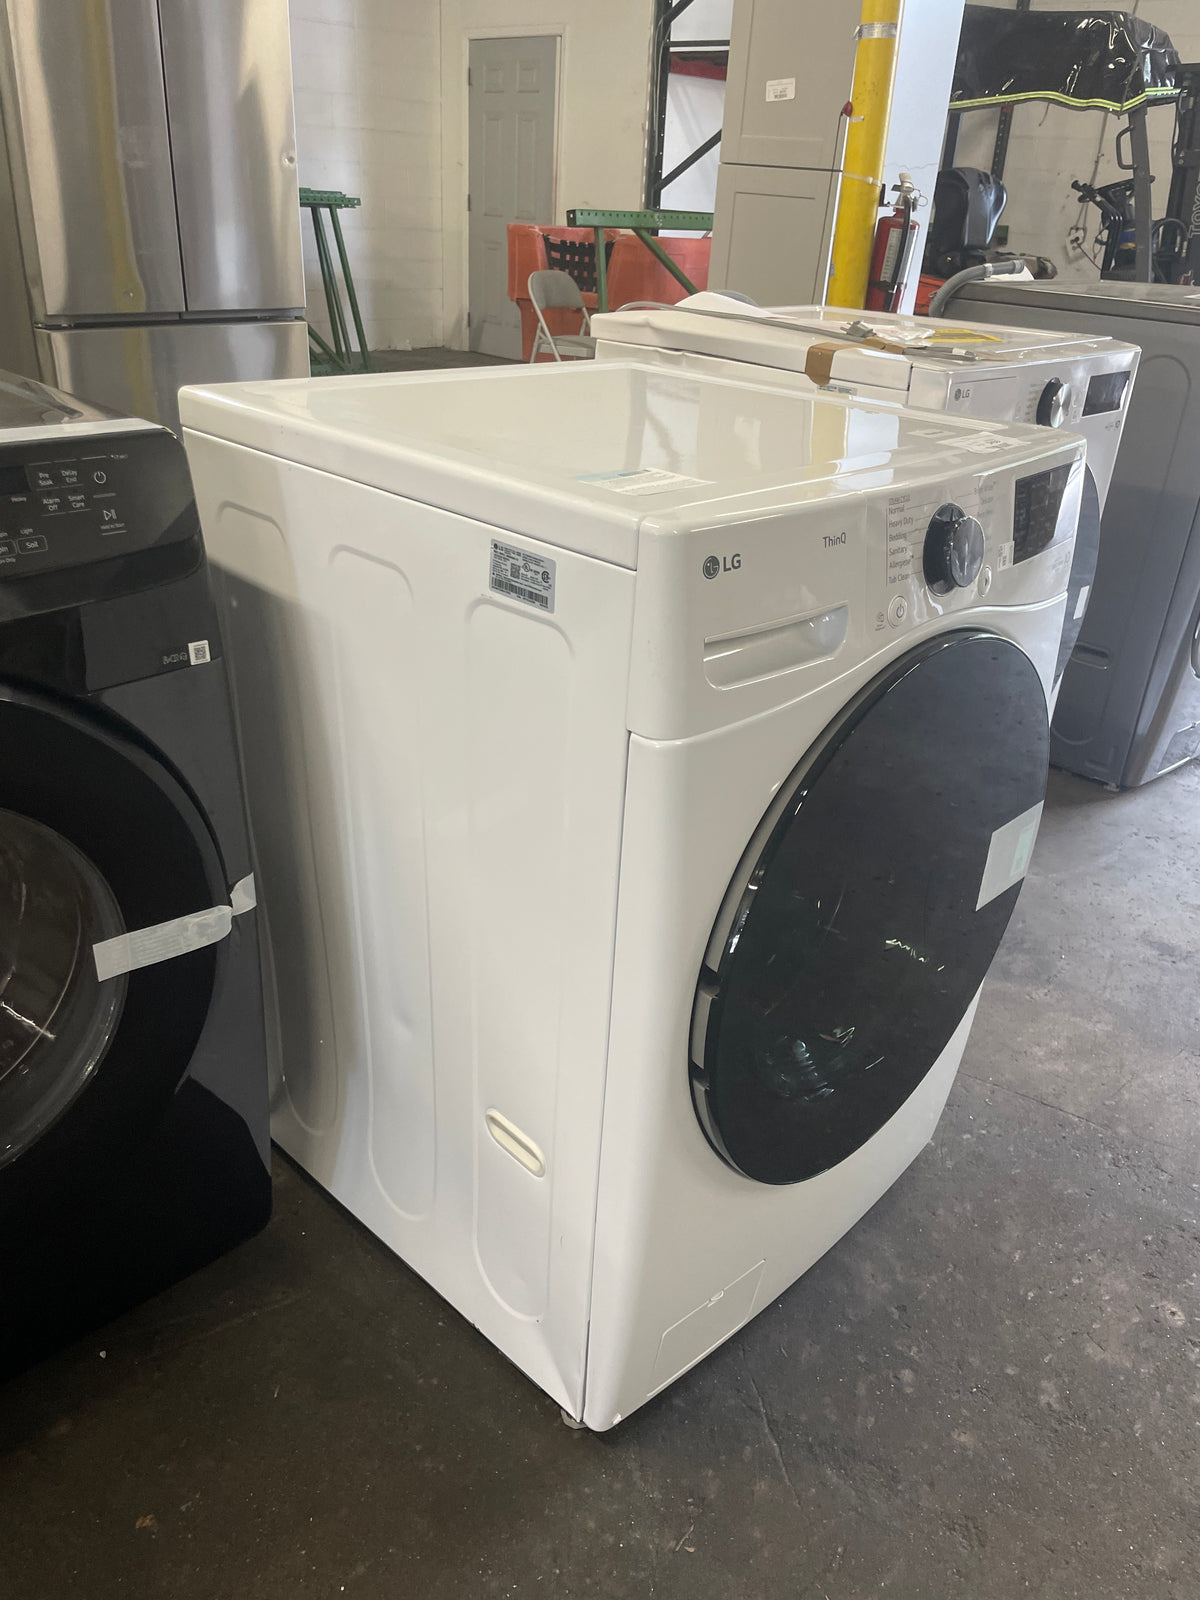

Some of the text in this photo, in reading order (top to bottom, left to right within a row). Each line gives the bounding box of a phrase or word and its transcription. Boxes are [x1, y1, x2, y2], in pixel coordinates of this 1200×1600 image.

[962, 389, 970, 398] LG
[903, 517, 914, 526] Duty
[822, 531, 847, 548] ThinQ
[25, 541, 39, 549] Soil
[723, 553, 742, 572] LG
